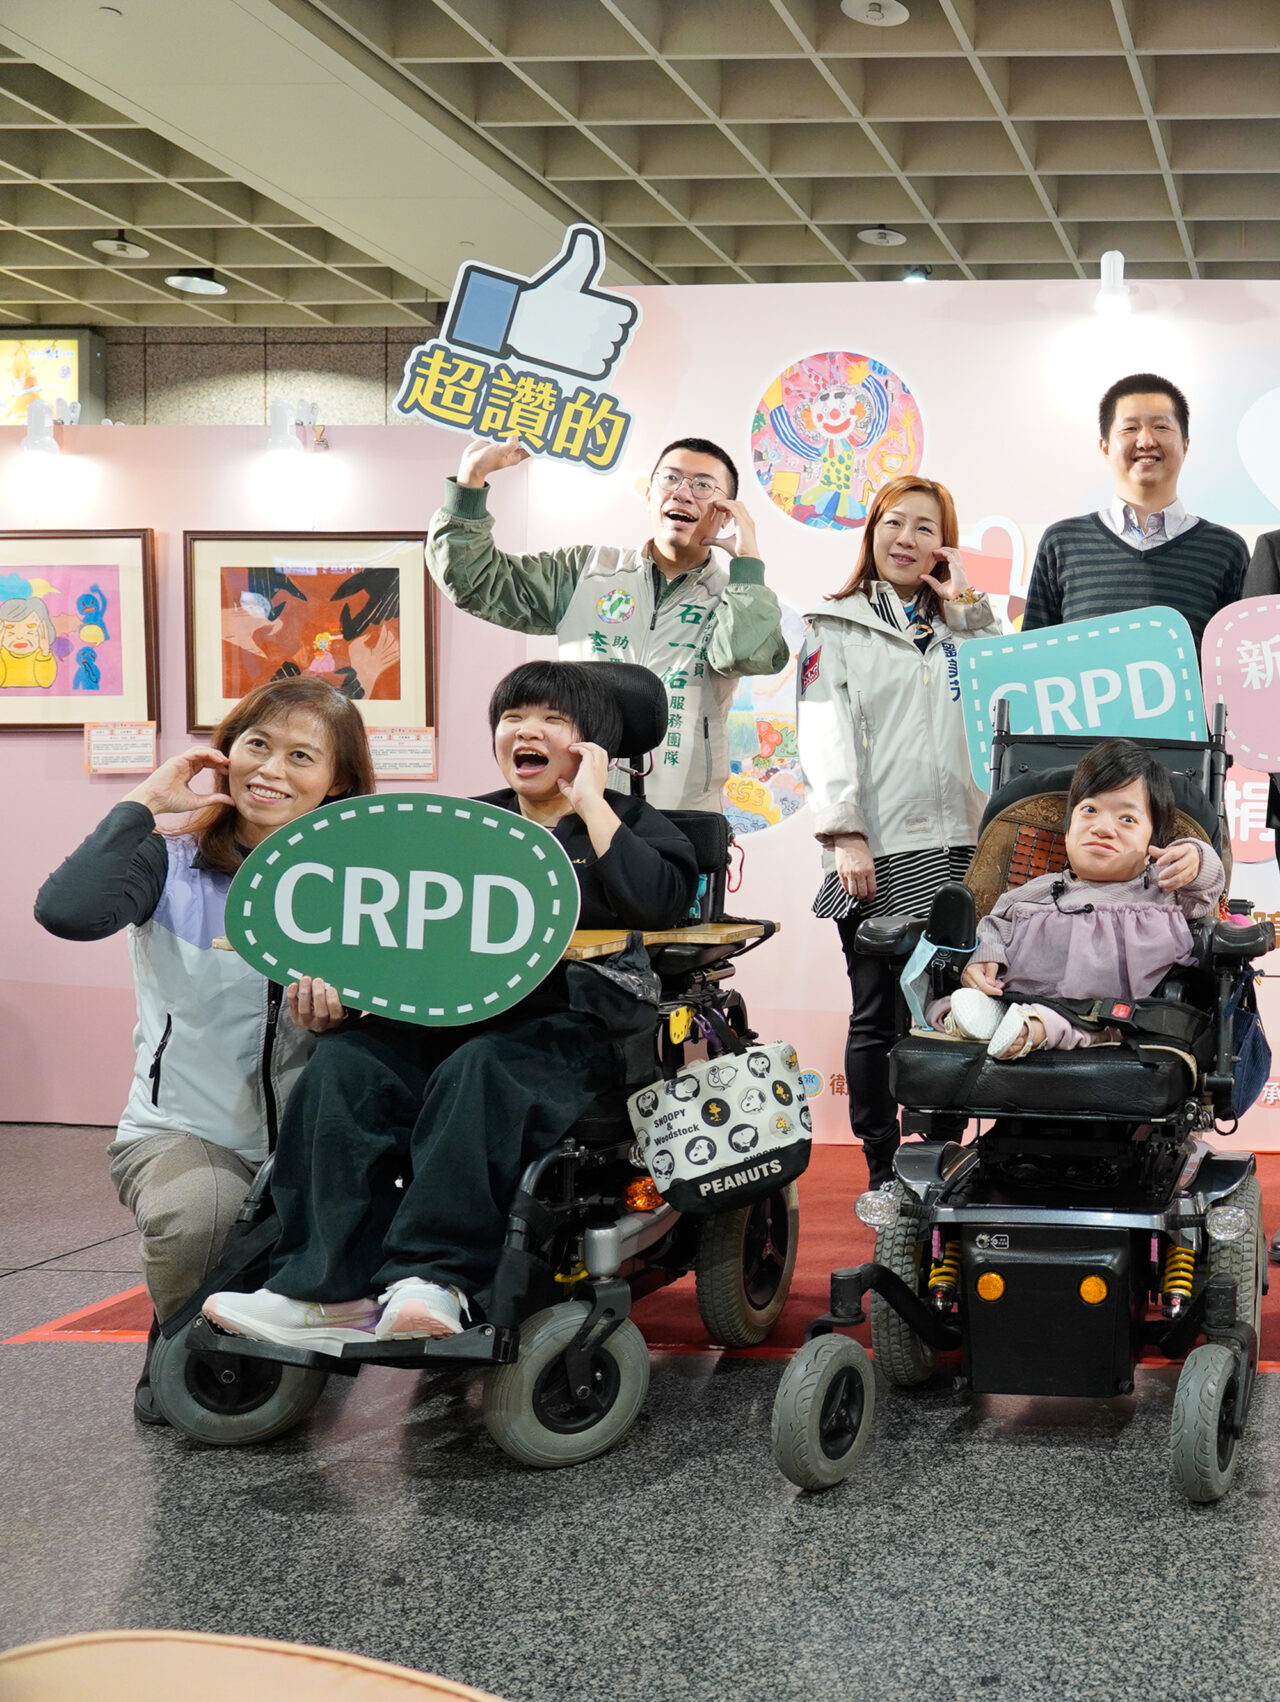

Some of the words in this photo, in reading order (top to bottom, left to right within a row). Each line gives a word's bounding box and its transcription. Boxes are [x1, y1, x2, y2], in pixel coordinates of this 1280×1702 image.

[403, 349, 626, 466] 超讚的
[989, 661, 1176, 735] CRPD
[274, 862, 535, 954] CRPD
[654, 1108, 686, 1129] SNOOPY
[654, 1123, 700, 1146] Woodstock
[667, 1122, 674, 1131] &
[699, 1159, 782, 1197] PEANUTS
